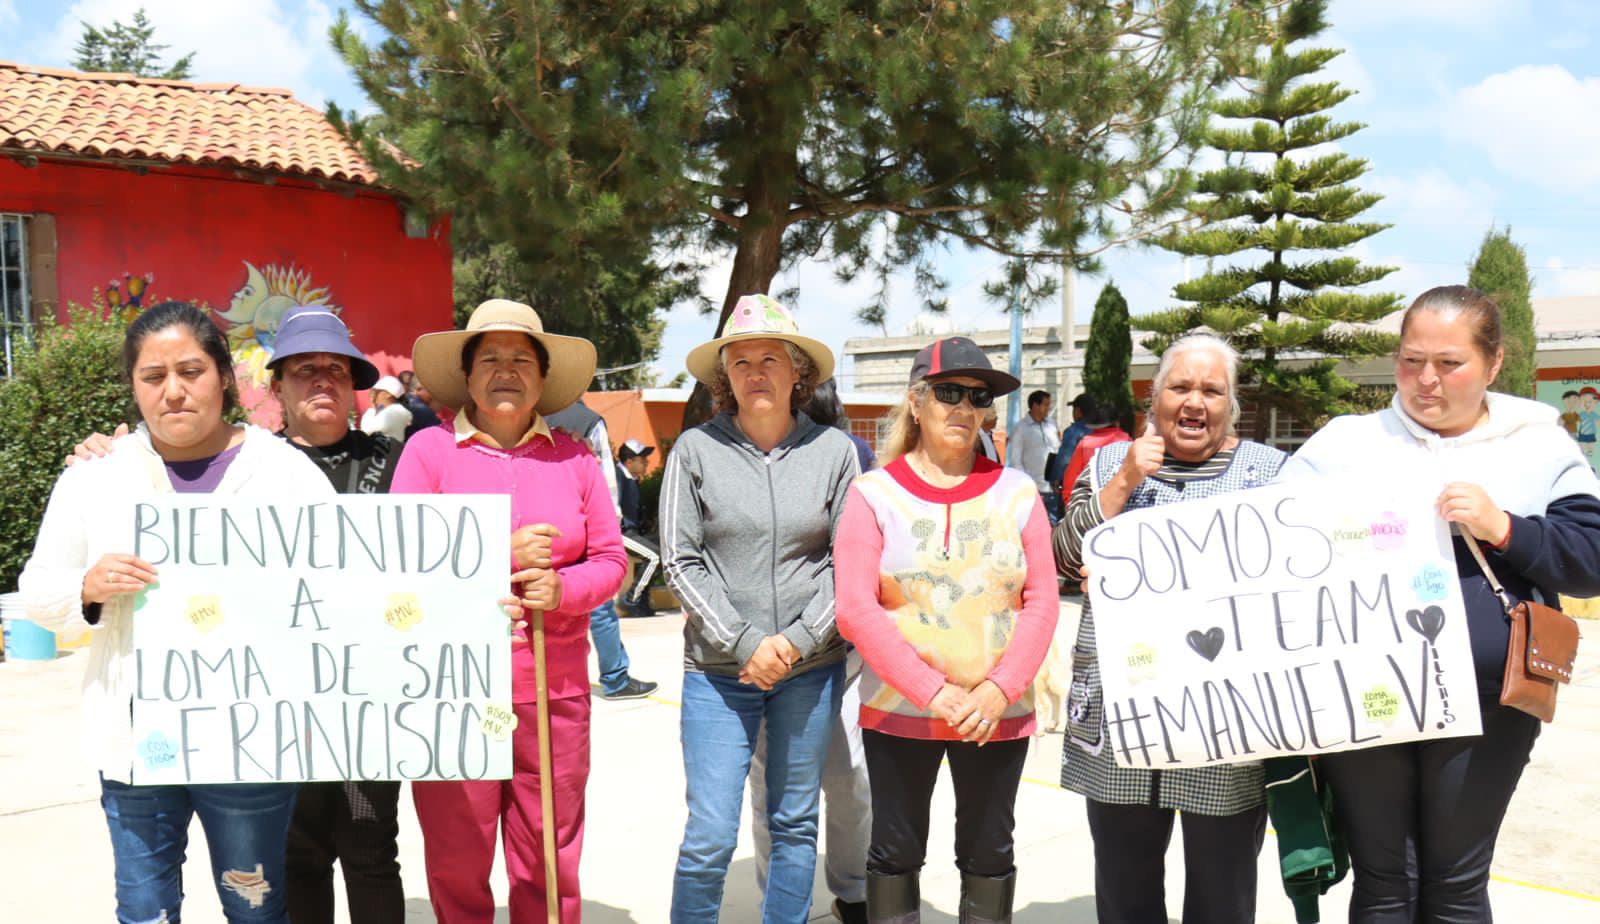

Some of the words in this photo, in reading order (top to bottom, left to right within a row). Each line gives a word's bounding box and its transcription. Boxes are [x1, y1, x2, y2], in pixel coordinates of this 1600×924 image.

[134, 502, 483, 579] BIENVENIDO
[1090, 497, 1333, 601] SOMOS
[289, 577, 331, 631] A
[1206, 573, 1403, 651] TEAM
[136, 645, 271, 702] LOMA
[311, 642, 369, 696] DE
[401, 642, 491, 700] SAN
[180, 700, 489, 782] FRANCISCO
[1108, 659, 1383, 767] #MANUEL
